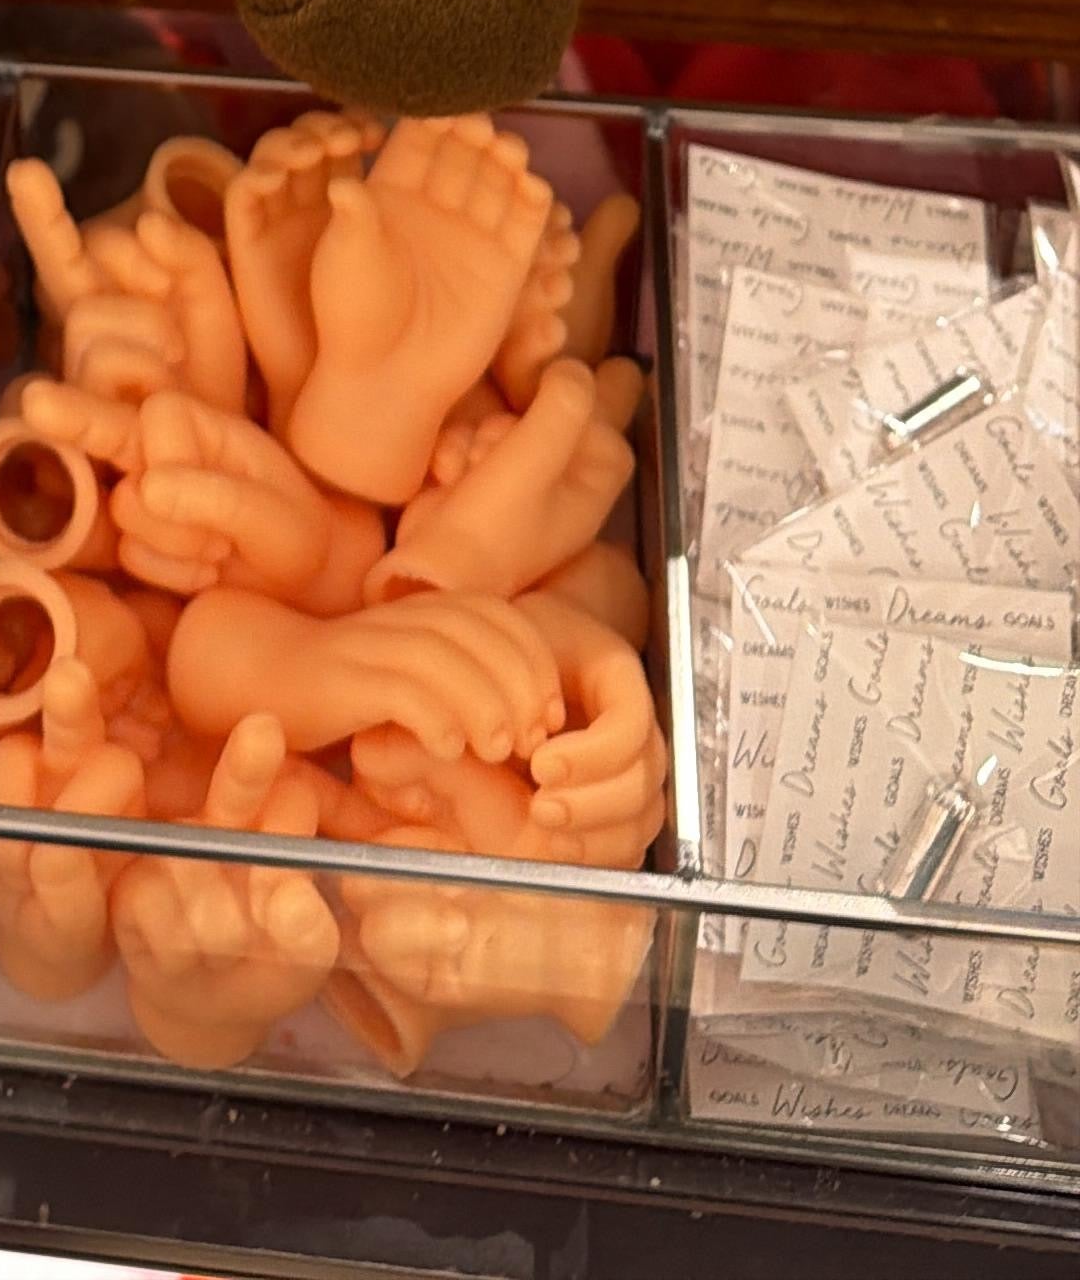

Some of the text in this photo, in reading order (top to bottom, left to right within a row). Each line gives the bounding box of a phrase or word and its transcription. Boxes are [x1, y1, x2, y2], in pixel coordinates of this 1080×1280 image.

[824, 595, 870, 613] WISHES
[887, 585, 988, 629] Dreams
[1003, 611, 1055, 631] GOALS
[887, 637, 934, 742] Dreams
[780, 693, 828, 798] Dreams
